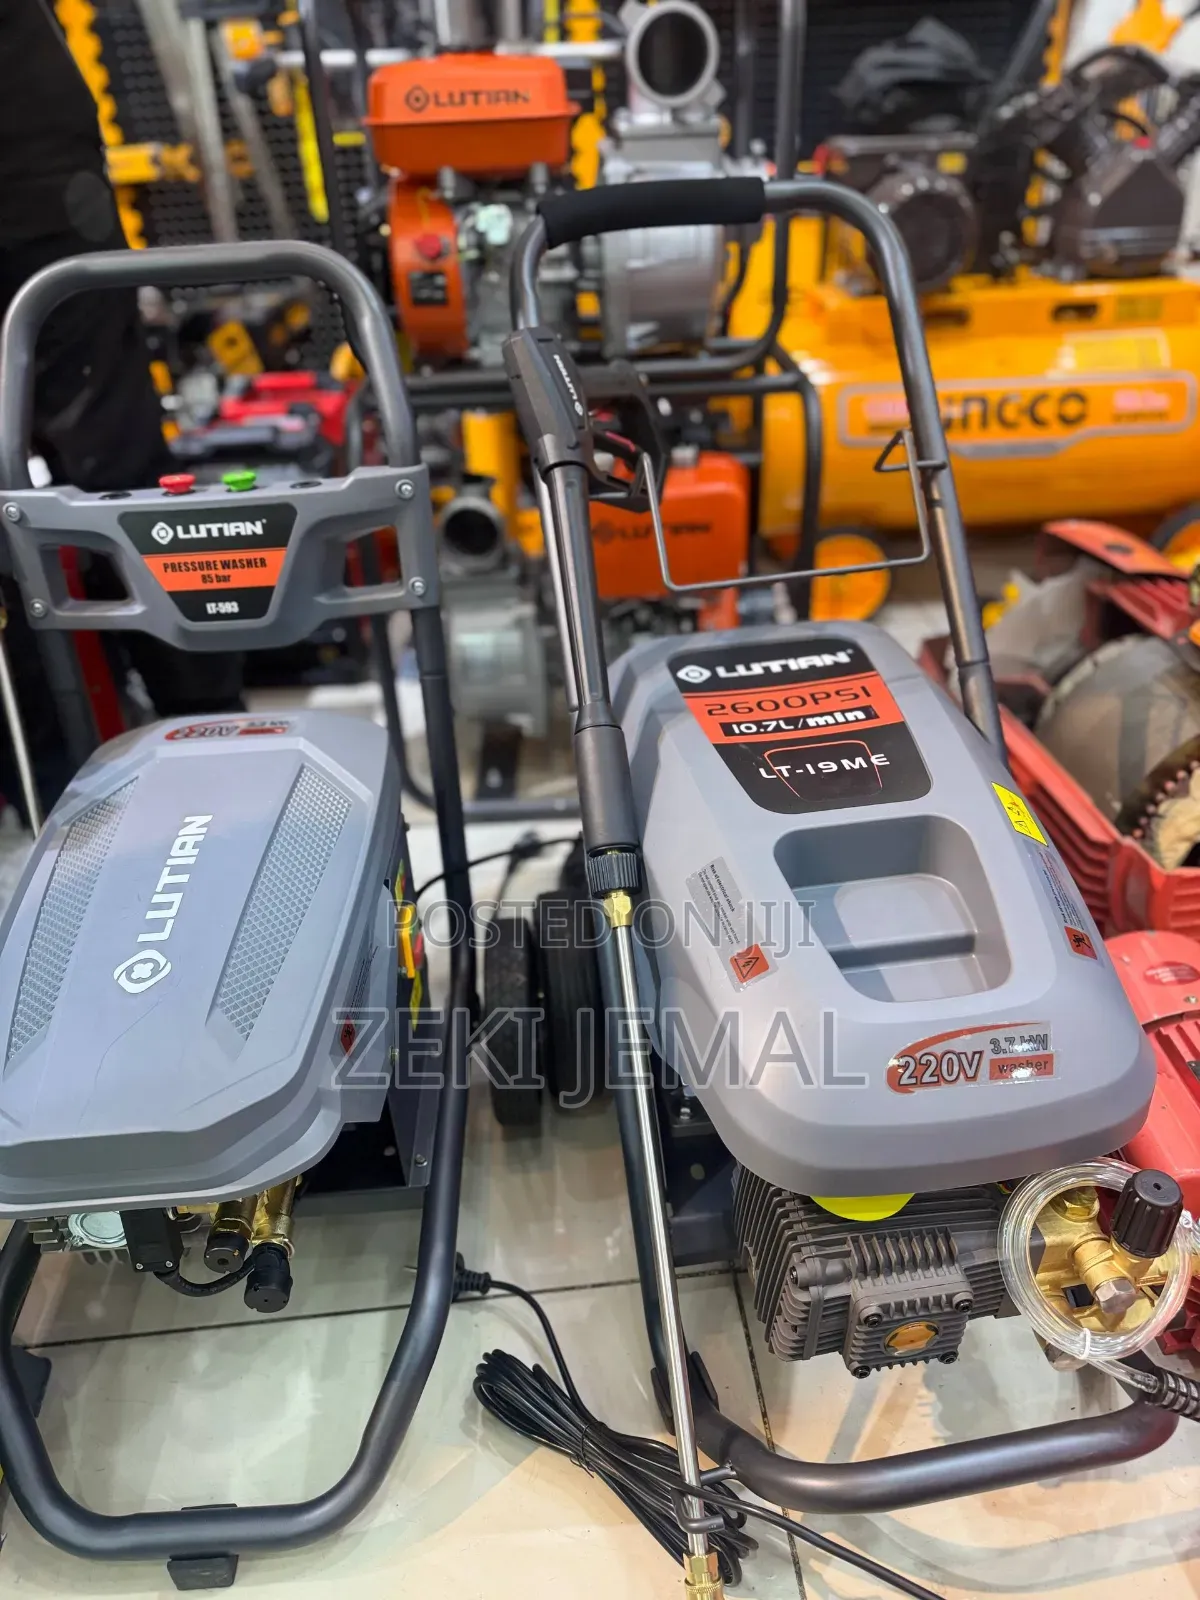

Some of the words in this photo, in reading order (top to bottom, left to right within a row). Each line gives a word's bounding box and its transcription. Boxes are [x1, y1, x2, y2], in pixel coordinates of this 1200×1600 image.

[433, 88, 531, 108] LUTIAN
[176, 520, 264, 539] LUTIAN
[163, 560, 219, 573] PRESSURE
[219, 557, 267, 571] WASHER
[201, 573, 214, 584] 85
[215, 573, 231, 583] bar
[716, 651, 851, 678] LUTIAN
[705, 685, 872, 717] 2600PSI
[732, 709, 866, 734] 10.7L/min
[758, 753, 890, 780] LT-19ME
[136, 814, 213, 943] LUTIAN
[897, 1049, 984, 1087] 220V
[997, 1059, 1049, 1077] washer
